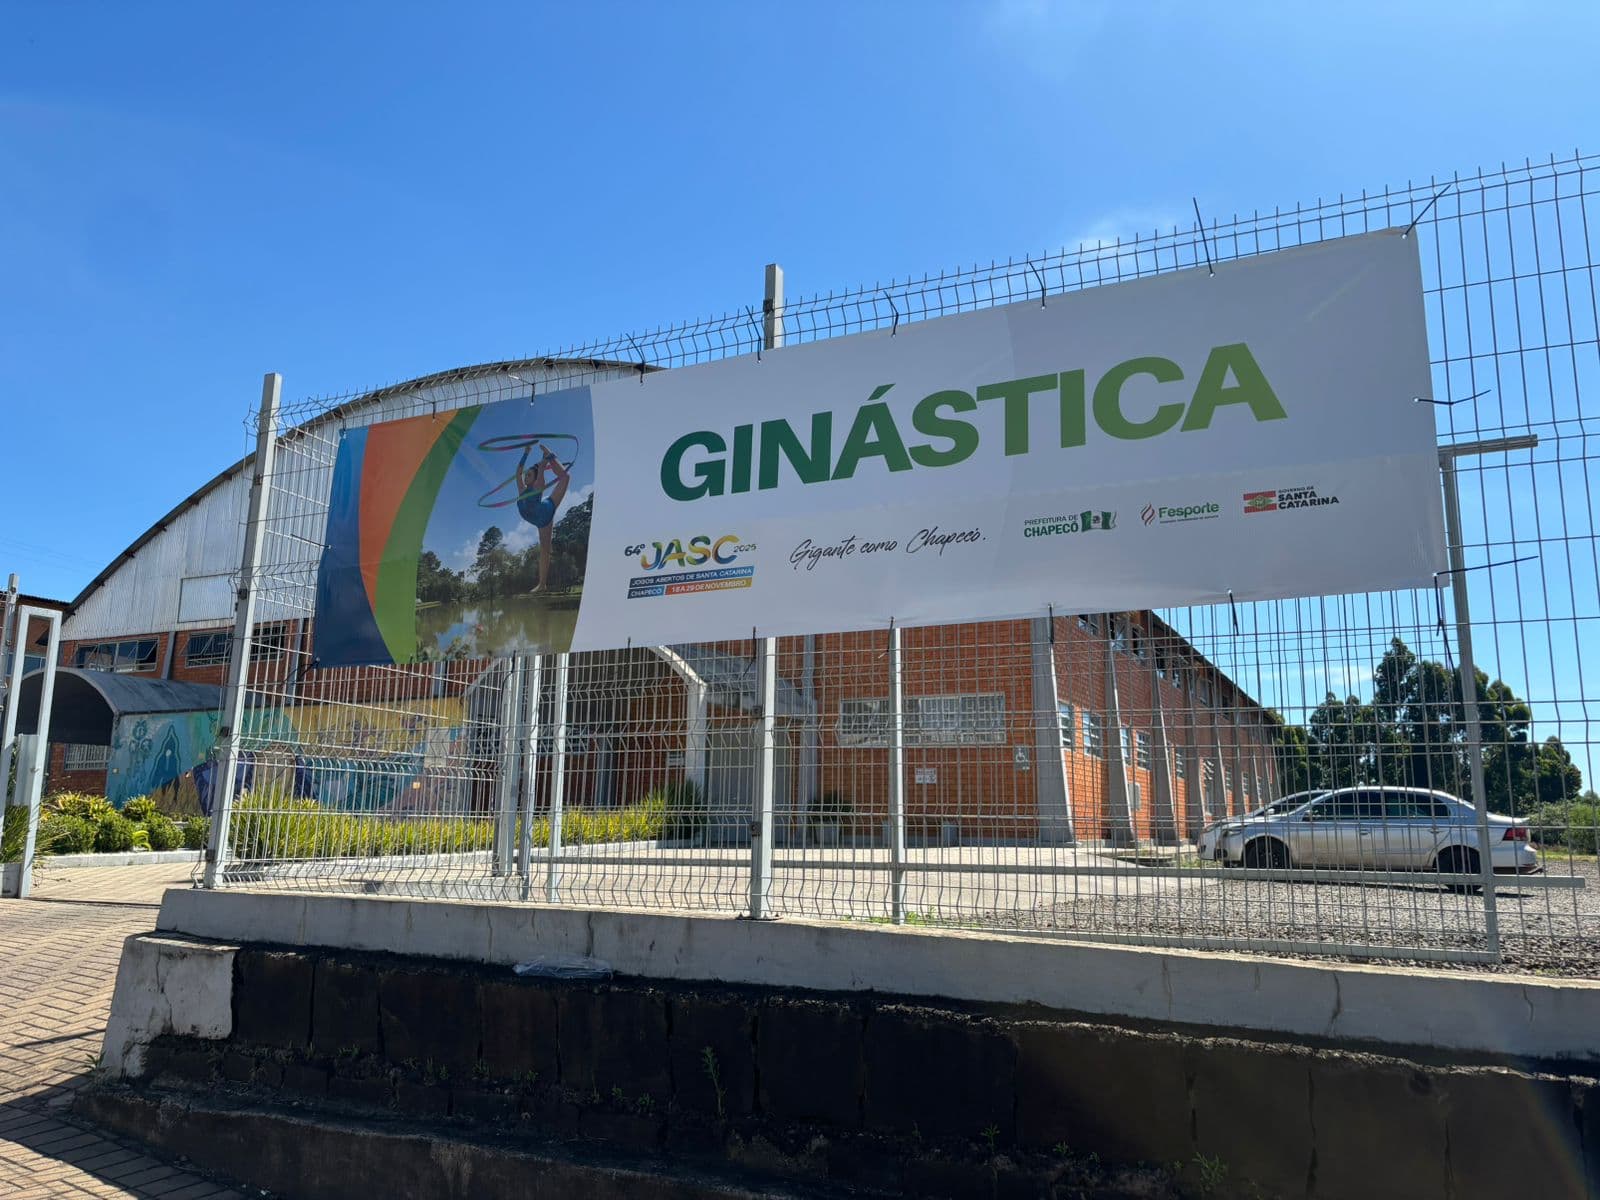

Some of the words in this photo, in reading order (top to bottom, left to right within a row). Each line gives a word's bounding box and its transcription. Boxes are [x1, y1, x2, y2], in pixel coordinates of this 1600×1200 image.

[660, 342, 1288, 501] GINÁSTICA
[1278, 491, 1317, 502] SANTA
[1278, 496, 1340, 510] CATARINA
[1158, 502, 1219, 518] Fesporte
[1024, 516, 1067, 526] PREFEITURA
[1023, 521, 1079, 538] CHAPECÓ
[640, 534, 740, 571] JASC
[733, 543, 757, 553] 2025
[790, 535, 856, 570] Gigante
[860, 540, 898, 554] como
[631, 578, 654, 586] JOGOS
[656, 575, 686, 584] ABERTOS
[695, 570, 718, 579] SANTA
[719, 567, 752, 577] CATARINA
